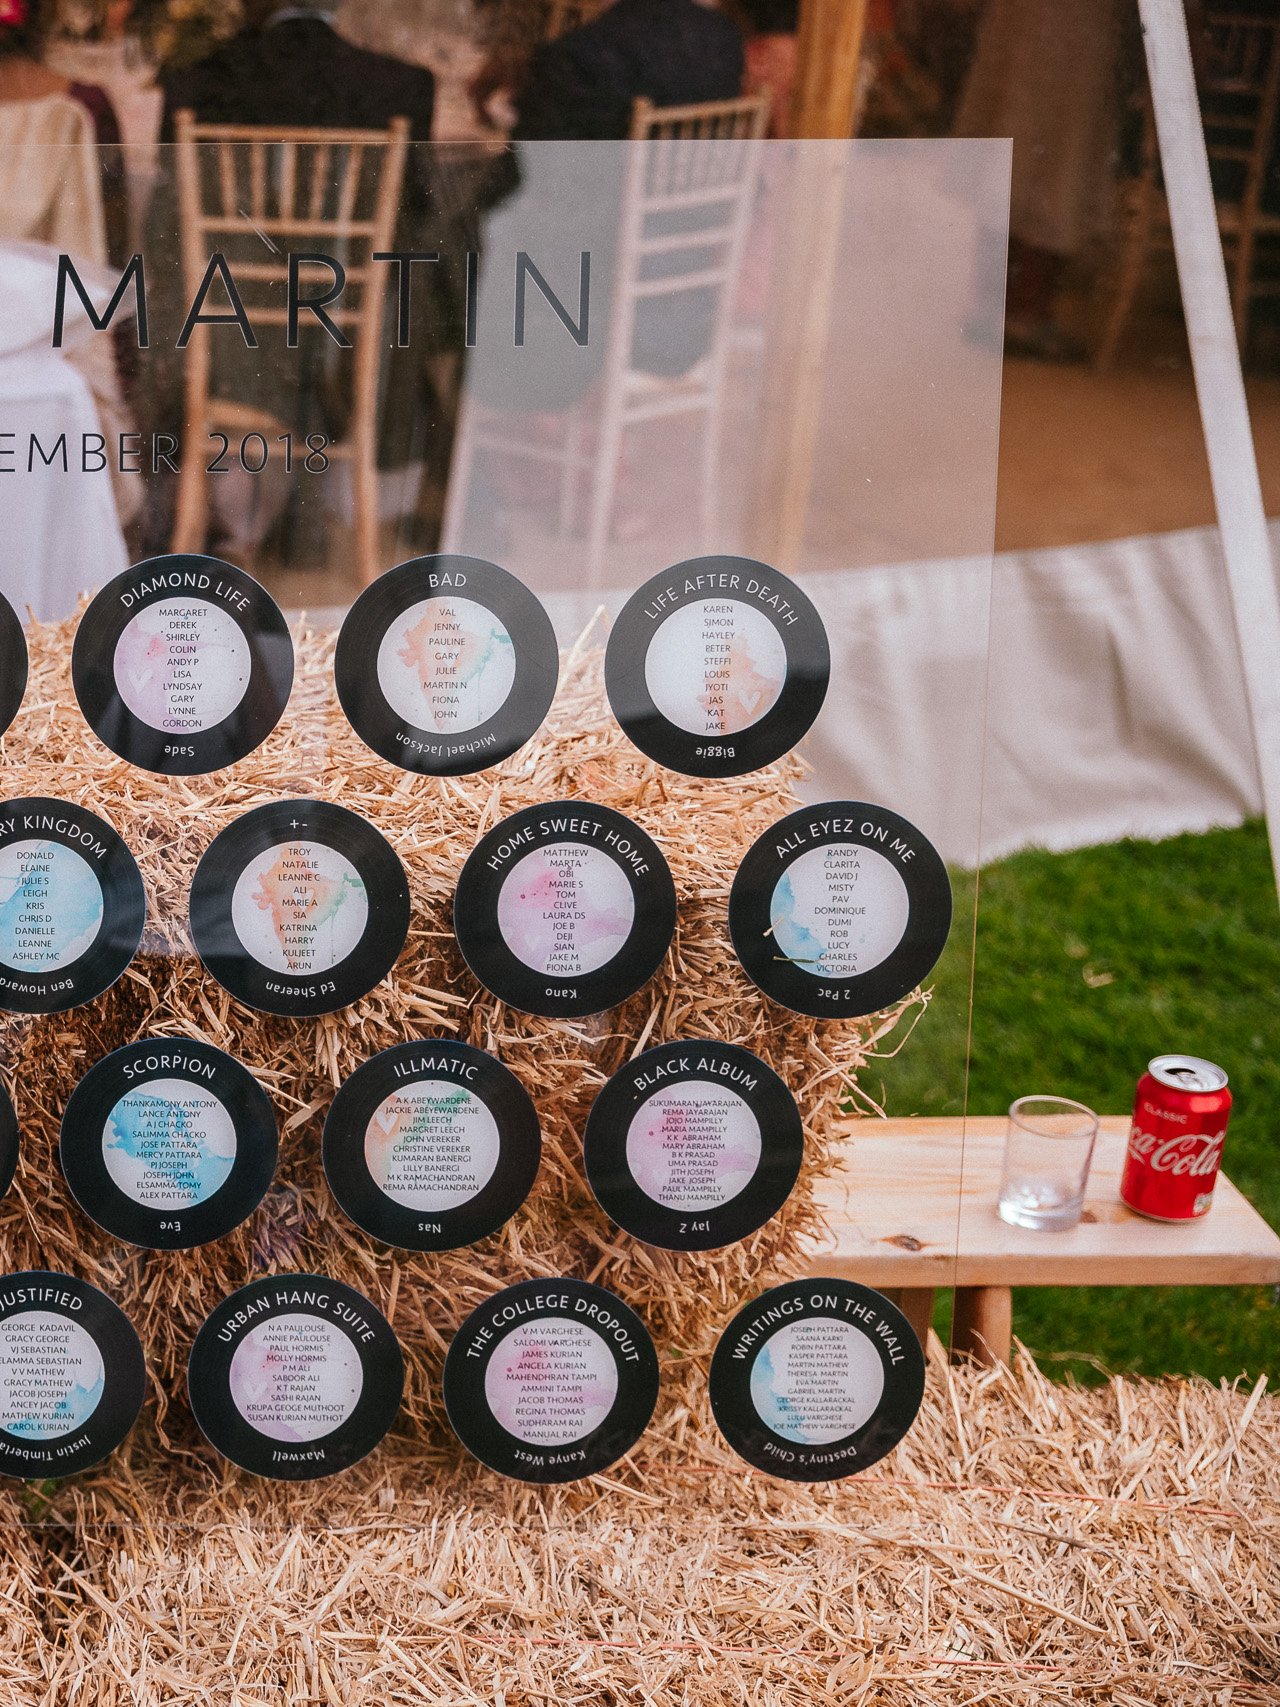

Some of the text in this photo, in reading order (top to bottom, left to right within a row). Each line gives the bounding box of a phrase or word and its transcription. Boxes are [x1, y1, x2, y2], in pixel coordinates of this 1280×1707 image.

[52, 250, 594, 349] MARTIN
[206, 431, 333, 475] 2018
[428, 573, 466, 588] BAD
[120, 573, 250, 611] DIAMOND LIFE
[644, 574, 798, 625] LIFE AFTER DEATH
[158, 608, 208, 619] MARGARET
[703, 605, 734, 614] KAREN
[428, 637, 466, 646] PAULINE
[164, 745, 195, 757] Sade
[396, 732, 496, 757] Michael Jackson
[695, 746, 735, 759] Biggie
[24, 815, 107, 859] KINGDOM
[776, 819, 915, 863] ALL EYEZ ON ME
[487, 818, 649, 876] HOME SWEET HOME
[543, 848, 589, 857] MATTHEW
[282, 860, 319, 869] NATALIE
[814, 906, 866, 916] DOMINIQUE
[14, 927, 56, 936] DANIELLE
[279, 923, 318, 932] KATRINA
[51, 978, 74, 991] Ben
[266, 981, 336, 998] Ed Sheeran
[545, 988, 577, 999] Kano
[817, 988, 851, 1000] 2 Pac
[123, 1055, 216, 1079] SCORPION
[394, 1057, 478, 1080] ILLMATIC
[633, 1058, 757, 1091] BLACK ALBUM
[138, 1108, 202, 1119] LANCE ANTONY
[392, 1144, 471, 1153] CHRISTINE VEREKER
[667, 1159, 719, 1168] UMA PRASAD
[160, 1221, 181, 1231] Eve
[418, 1223, 441, 1233] Nas
[679, 1221, 710, 1233] Jay Z
[218, 1291, 375, 1343] URBAN HANG SUITE
[466, 1294, 639, 1361] THE COLLEGE DROPOUT
[732, 1295, 905, 1365] WRITINGS ON THE WALL
[4, 1334, 70, 1344] GRACY GEORGE
[521, 1350, 583, 1359] JAMES KURIAN
[787, 1361, 850, 1369] MARTIN MATHEW
[272, 1373, 321, 1383] SABOOR ALI
[56, 1435, 91, 1456] Justin
[273, 1449, 325, 1462] Maxwell
[514, 1450, 586, 1466] Kanye West
[764, 1442, 857, 1465] Destiny's Child
